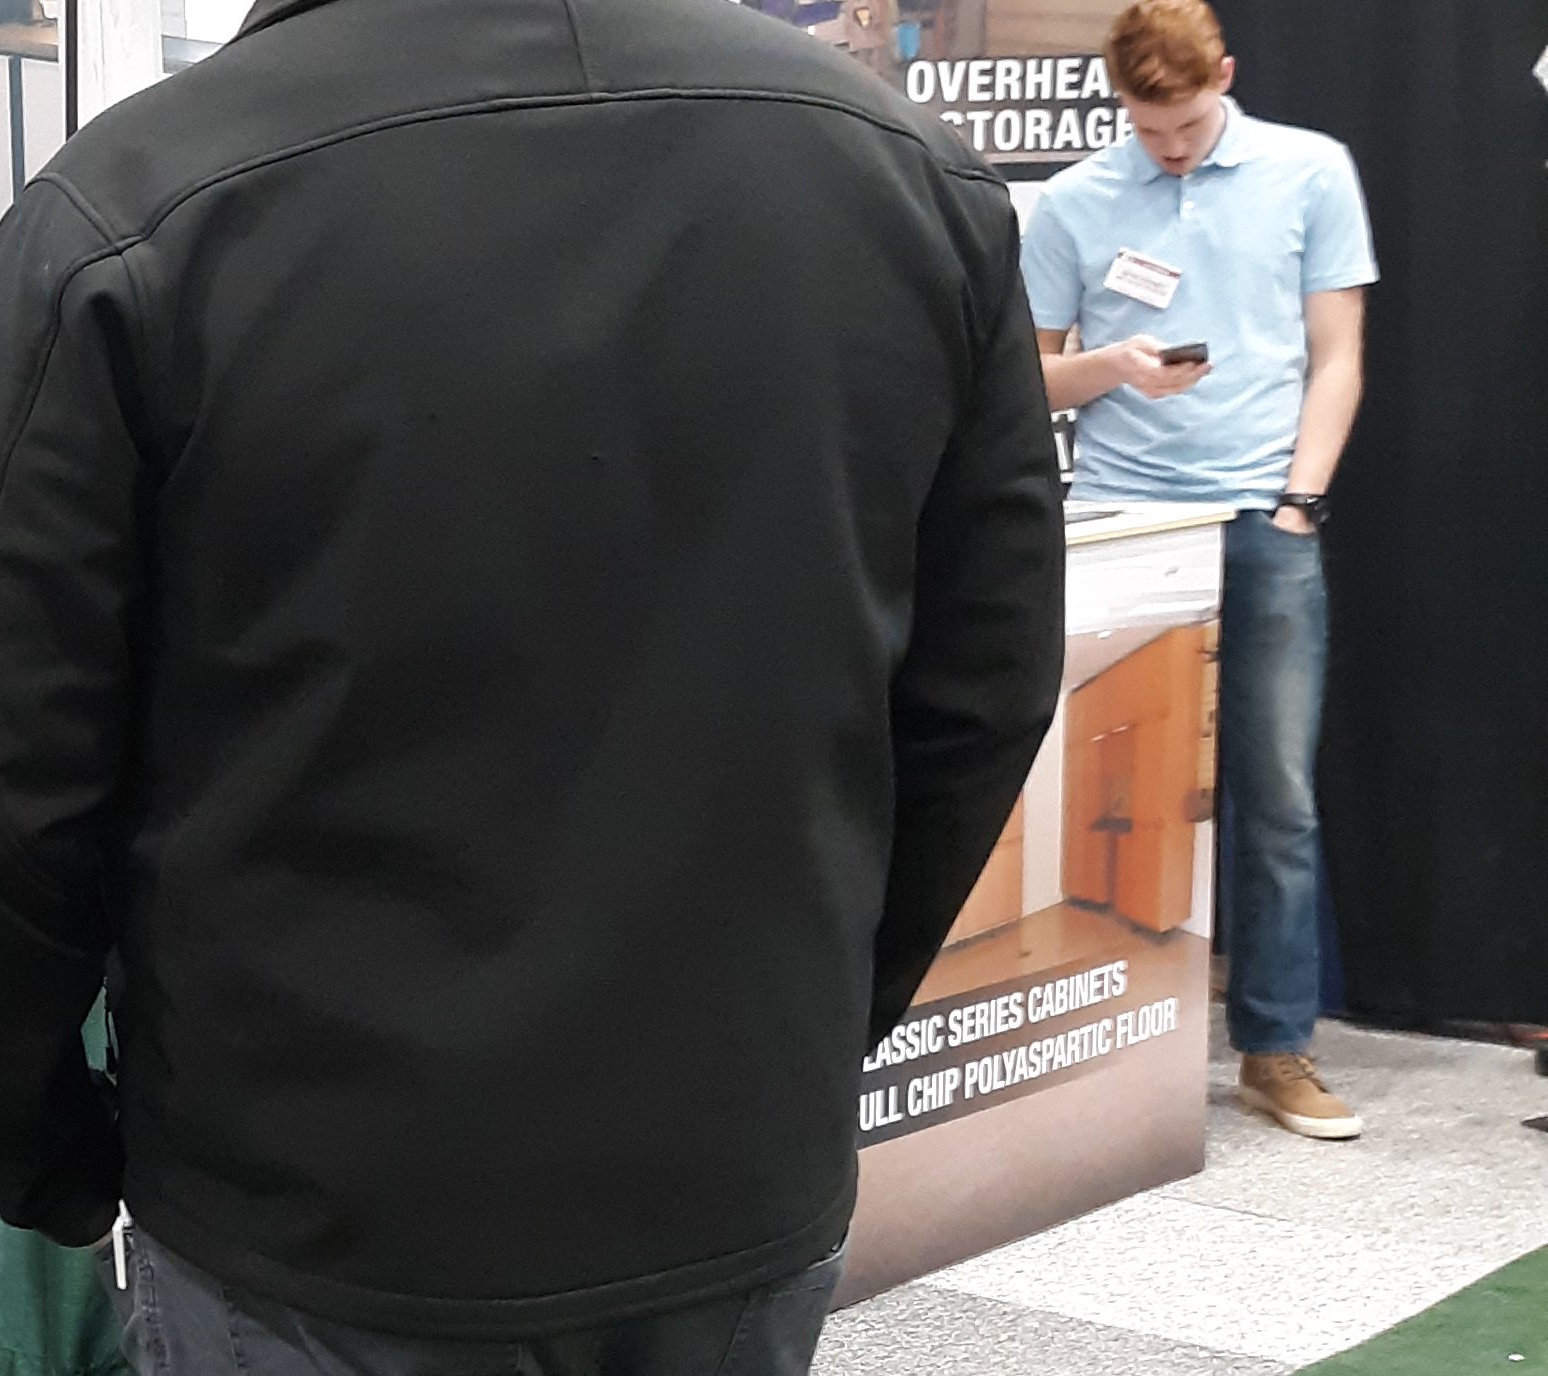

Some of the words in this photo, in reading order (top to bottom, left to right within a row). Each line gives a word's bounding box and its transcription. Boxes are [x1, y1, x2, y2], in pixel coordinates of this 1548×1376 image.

[906, 57, 1120, 103] OVERHEA
[948, 992, 1025, 1048] SERIES
[1028, 960, 1129, 1022] CABINETS
[908, 1067, 961, 1117] CHIP
[964, 1019, 1113, 1099] POLYASPARTIC
[1116, 997, 1179, 1049] FLOOR
